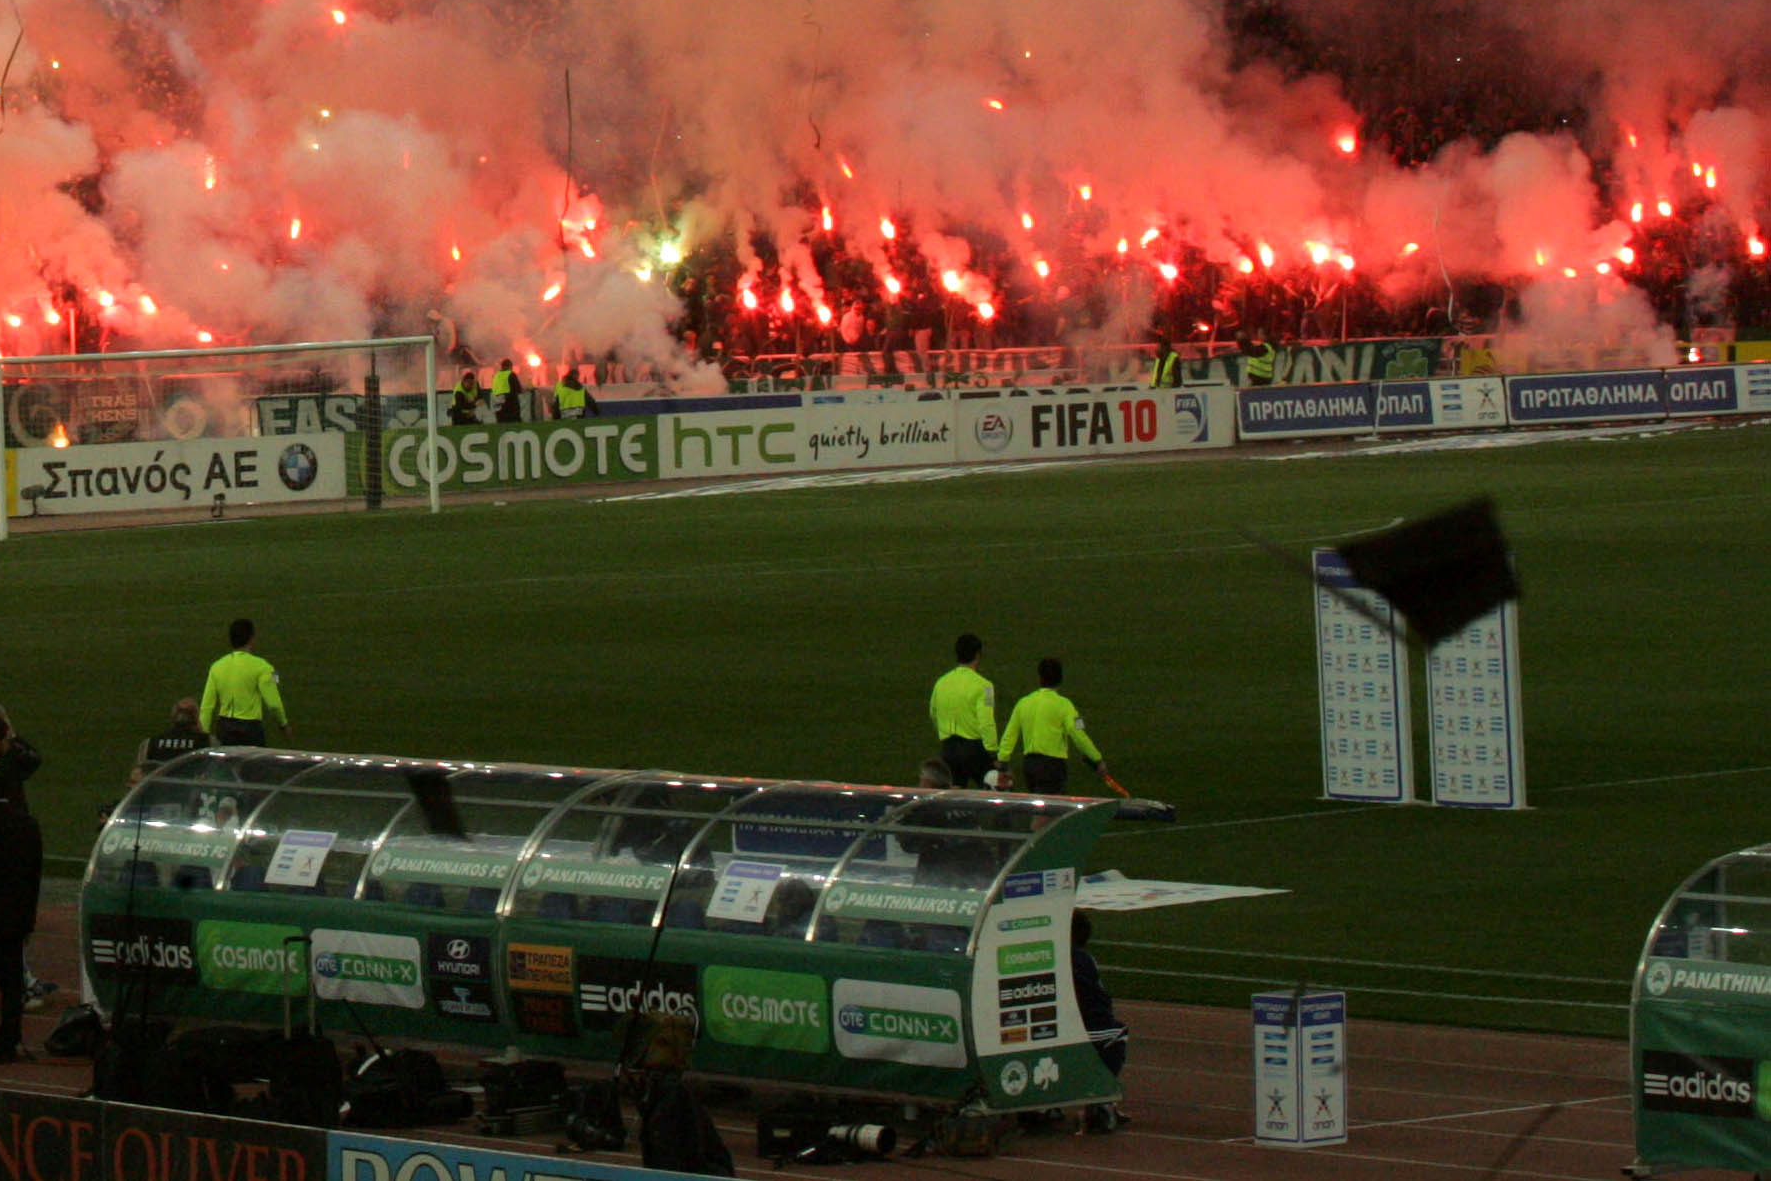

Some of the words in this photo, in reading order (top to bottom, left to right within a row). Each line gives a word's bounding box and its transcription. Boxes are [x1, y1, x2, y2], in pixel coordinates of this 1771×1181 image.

[1176, 394, 1198, 409] FIFA
[1520, 383, 1659, 409] ΠΡΩΤΑΘΛΗΜΑ
[1670, 379, 1727, 402] ΟΠΑΠ
[1248, 394, 1368, 421] ΠΡΩΤΑΘΛΗΜΑ
[982, 414, 1005, 432] EA
[1032, 401, 1114, 448] FIFA
[1118, 399, 1158, 443] 10
[809, 423, 870, 460] quietly
[879, 418, 951, 446] brilliant
[389, 423, 647, 487] COSMOTE
[43, 450, 192, 500] Σπανός
[157, 737, 196, 750] PRESS
[388, 857, 487, 878] PANATHINAIKOS
[487, 864, 509, 879] FC
[541, 868, 645, 889] PANATHINAIKOS
[645, 876, 665, 890] FC
[845, 891, 956, 914] PANATHINAIKOS
[957, 898, 979, 916] FC
[212, 943, 300, 974] COSMOTE
[341, 959, 415, 983] CONN-X
[437, 960, 481, 976] HYUNDAI
[1012, 982, 1056, 999] adidas
[721, 992, 821, 1027] COSMOTE
[869, 1015, 953, 1039] CONN-X
[1669, 1071, 1751, 1104] adidas
